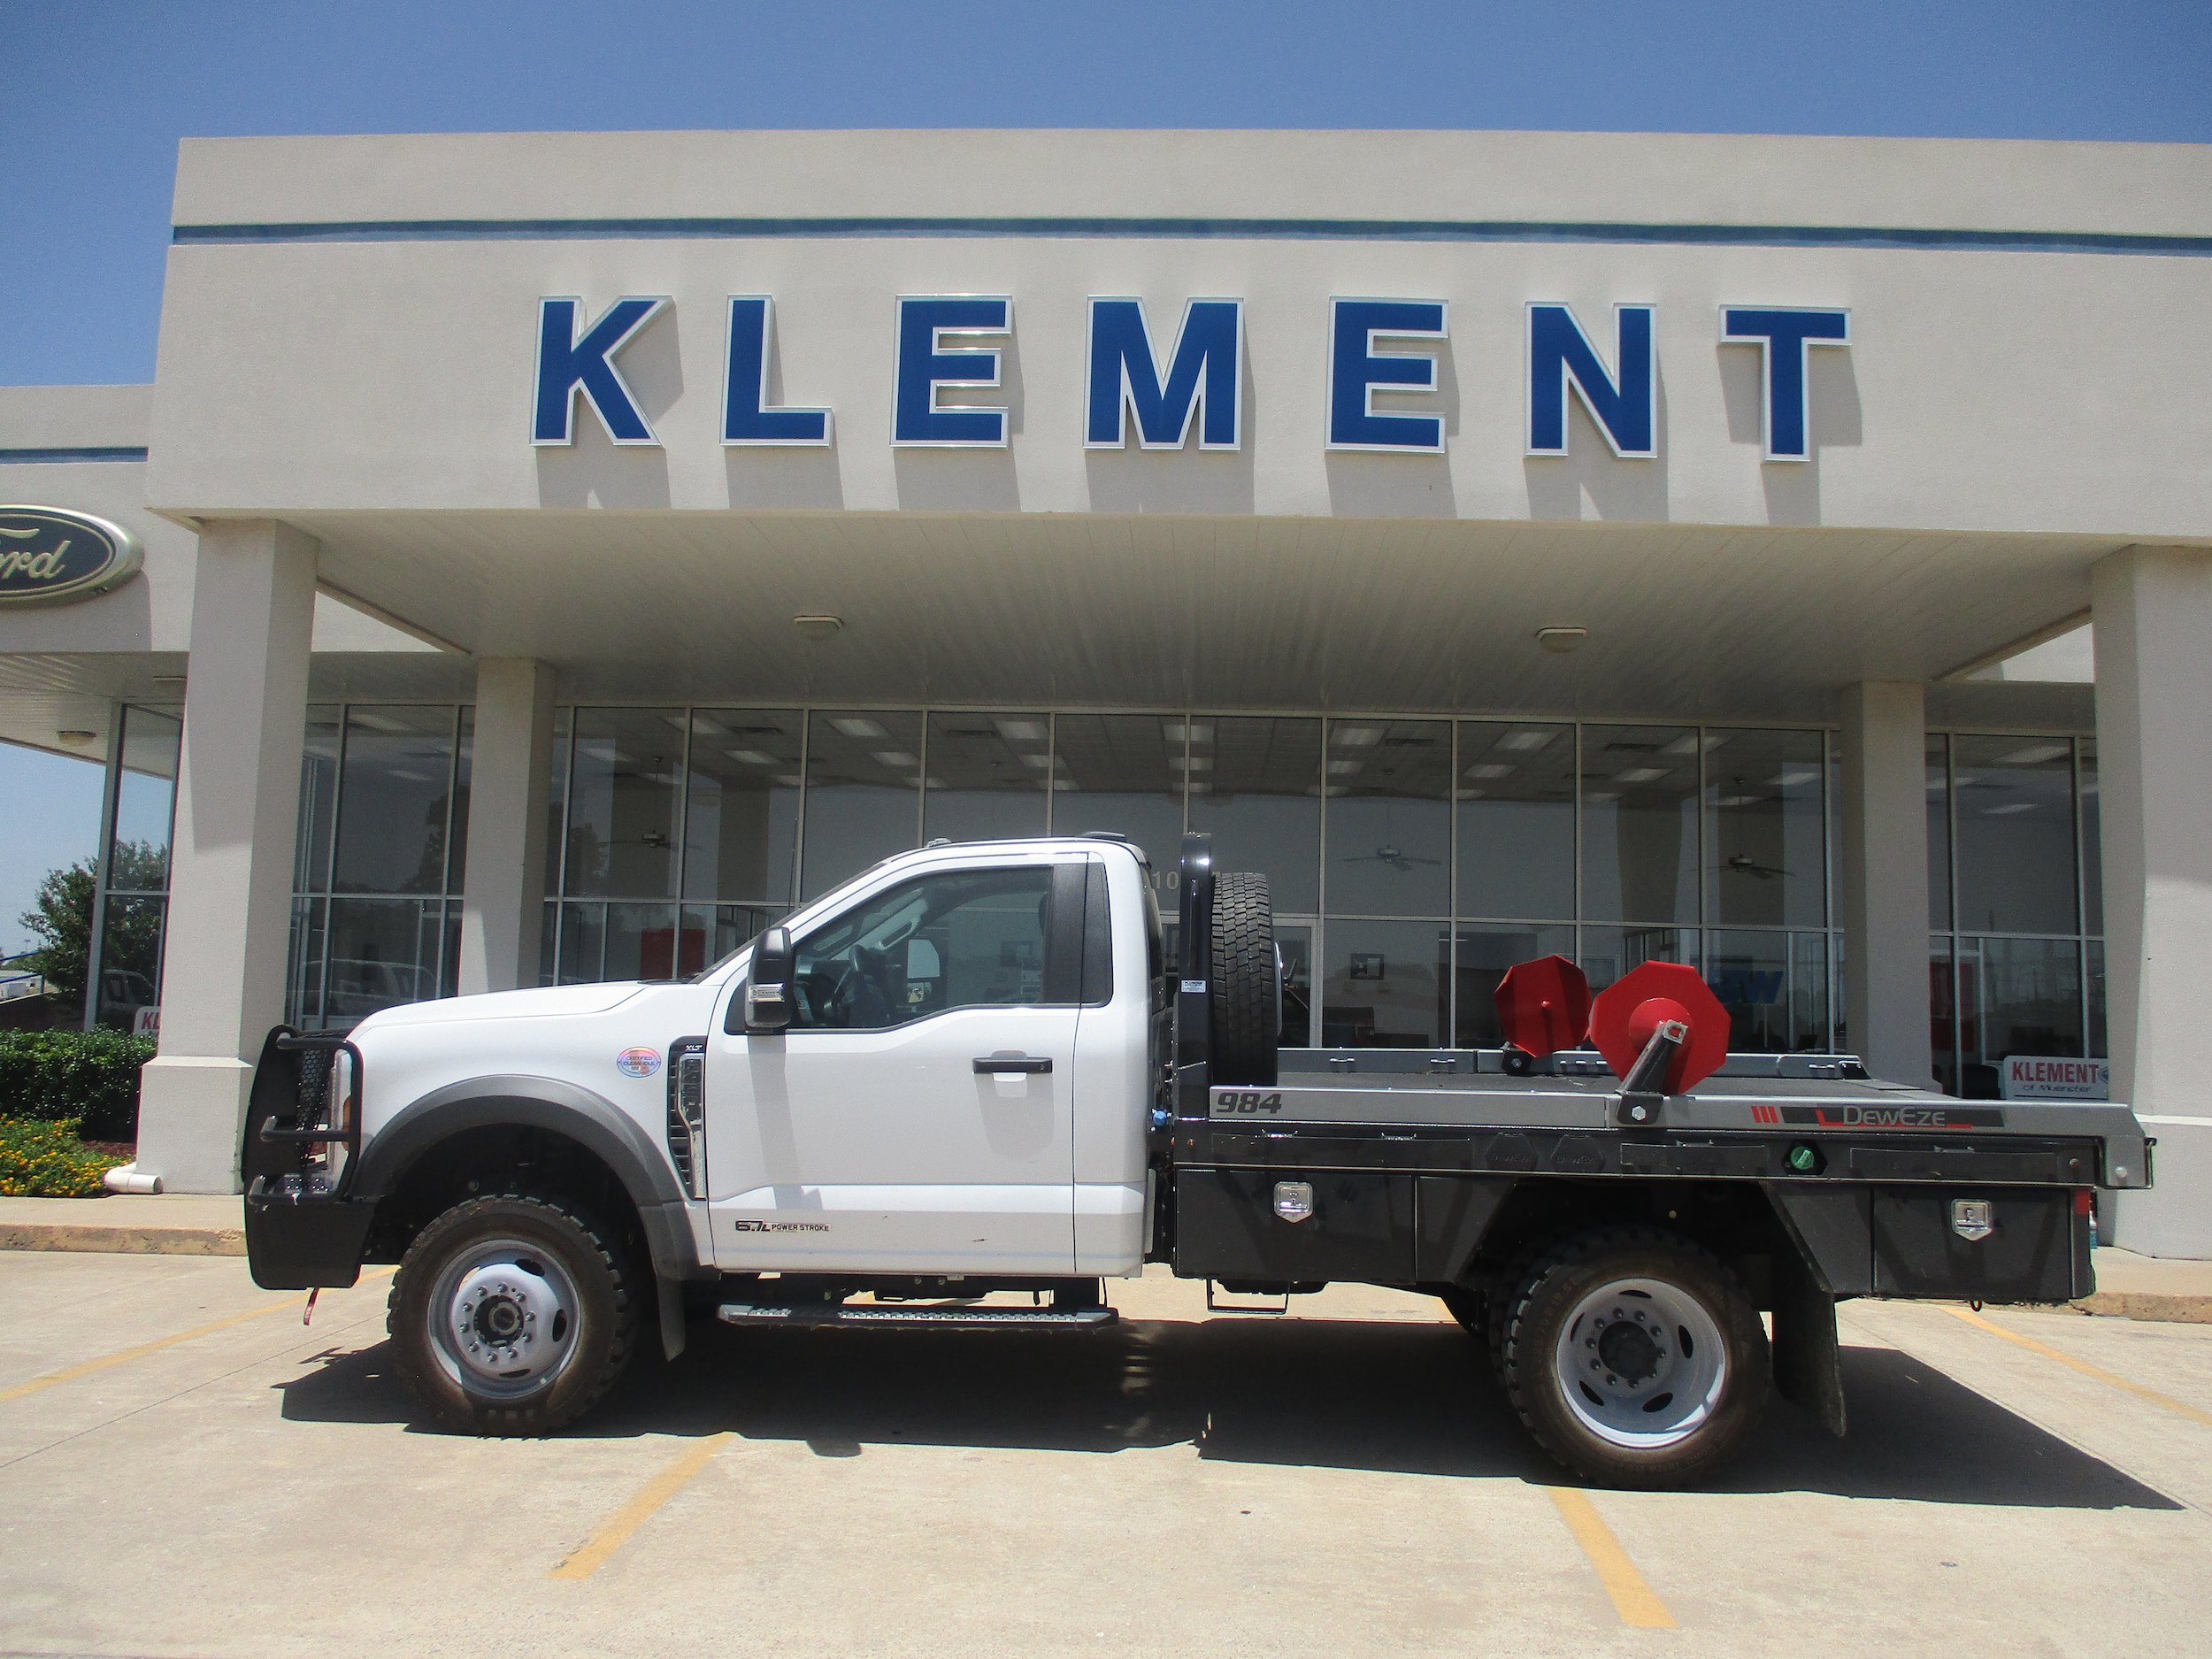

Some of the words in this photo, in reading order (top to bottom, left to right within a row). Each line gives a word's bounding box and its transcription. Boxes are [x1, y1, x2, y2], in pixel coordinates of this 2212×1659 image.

[529, 293, 1852, 463] KLEMENT
[2011, 1061, 2099, 1084] KLEMENT
[1216, 1092, 1282, 1114] 984
[735, 1219, 771, 1232] 6.7L
